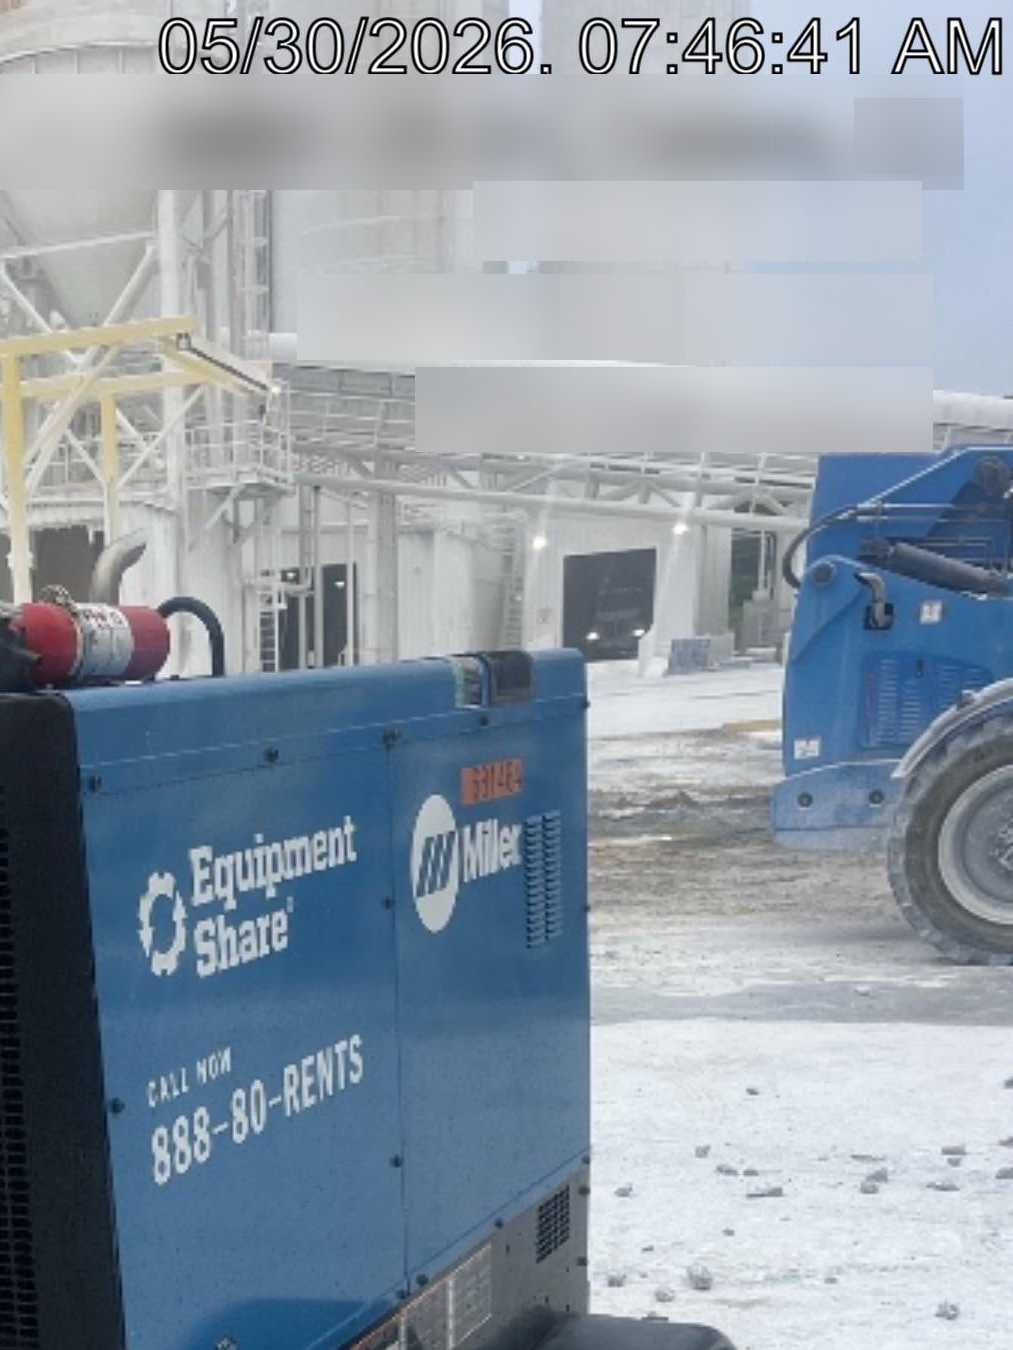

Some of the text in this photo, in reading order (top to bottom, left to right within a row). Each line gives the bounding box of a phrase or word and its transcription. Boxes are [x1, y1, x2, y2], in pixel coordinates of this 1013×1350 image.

[190, 815, 357, 911] Equipment
[463, 818, 522, 883] Miller
[146, 1046, 232, 1109] CALL NOW
[150, 1033, 364, 1186] 888-80-RENTS
